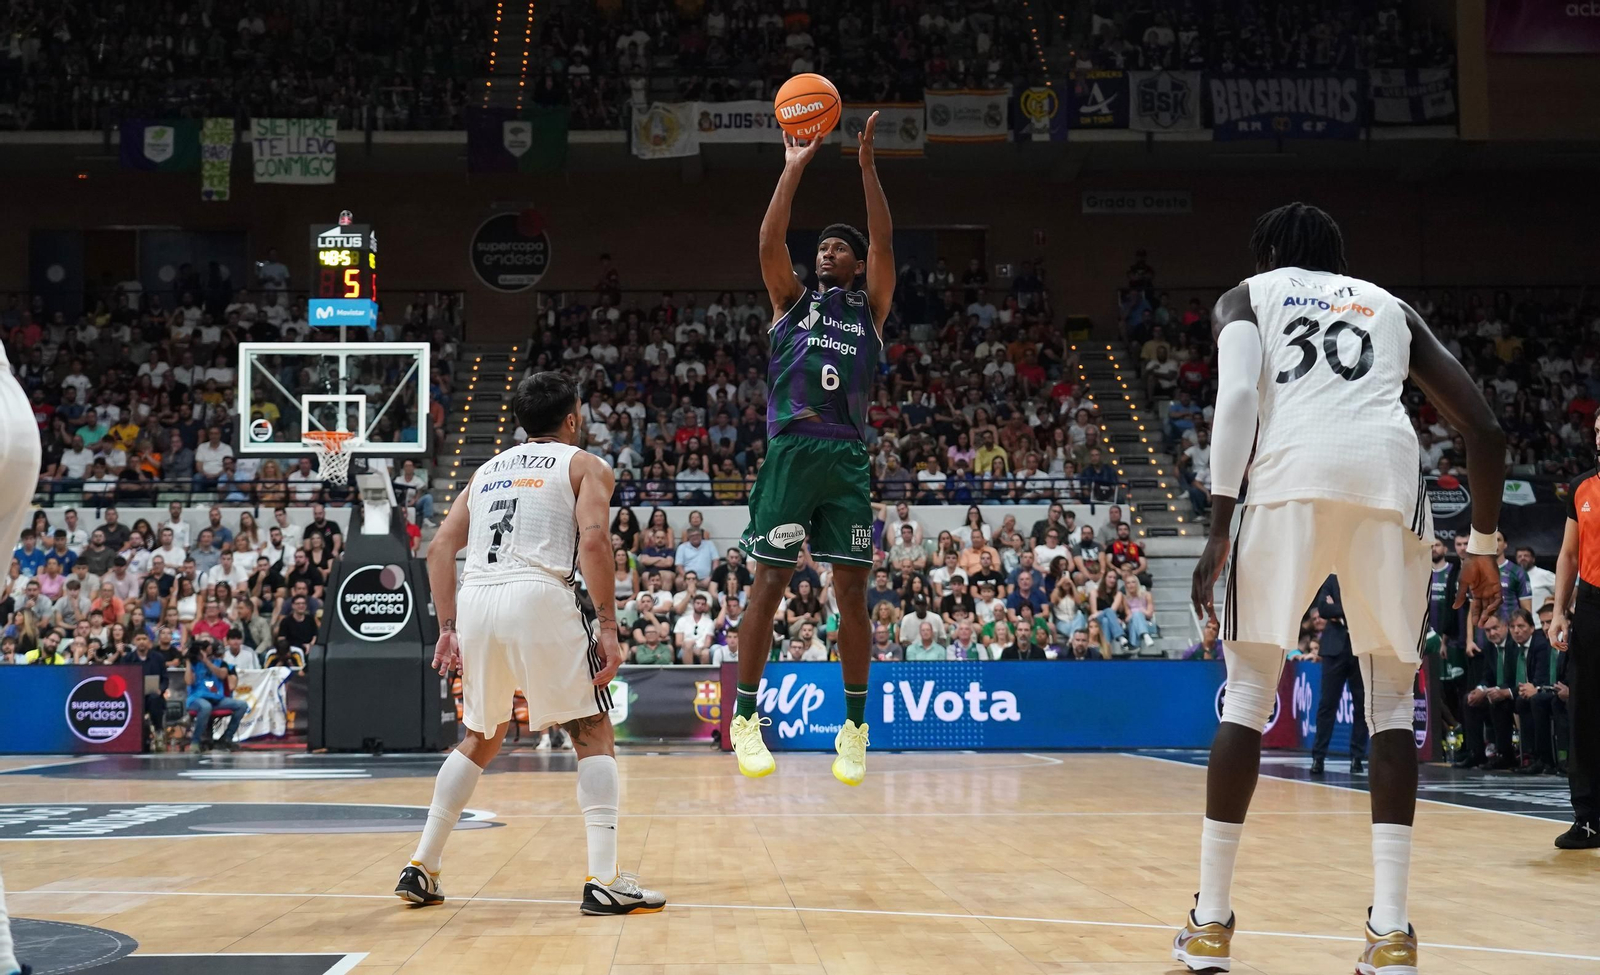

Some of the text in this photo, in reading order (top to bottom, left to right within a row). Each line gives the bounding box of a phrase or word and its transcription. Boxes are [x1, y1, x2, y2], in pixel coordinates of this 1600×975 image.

[780, 101, 824, 119] Wilson
[1140, 91, 1190, 117] BSK
[1209, 78, 1358, 126] BERSERKERS
[256, 118, 335, 138] SIEMPRE
[254, 138, 336, 156] TE LLEVO
[1086, 195, 1188, 208] Grada Oeste
[317, 237, 362, 248] LOTUS
[477, 241, 544, 253] supercopa
[482, 251, 544, 265] endesa
[344, 269, 360, 298] 5
[1283, 296, 1375, 318] AUTOHERO
[807, 334, 857, 355] málaga
[1275, 316, 1375, 384] 30
[821, 364, 840, 391] 6
[484, 454, 557, 475] CAMPAZZO
[481, 478, 544, 493] AUTOHERO
[487, 498, 519, 564] 7
[345, 593, 404, 603] supercopa
[350, 602, 404, 615] endesa
[71, 701, 126, 710] supercopa
[76, 709, 126, 721] endesa
